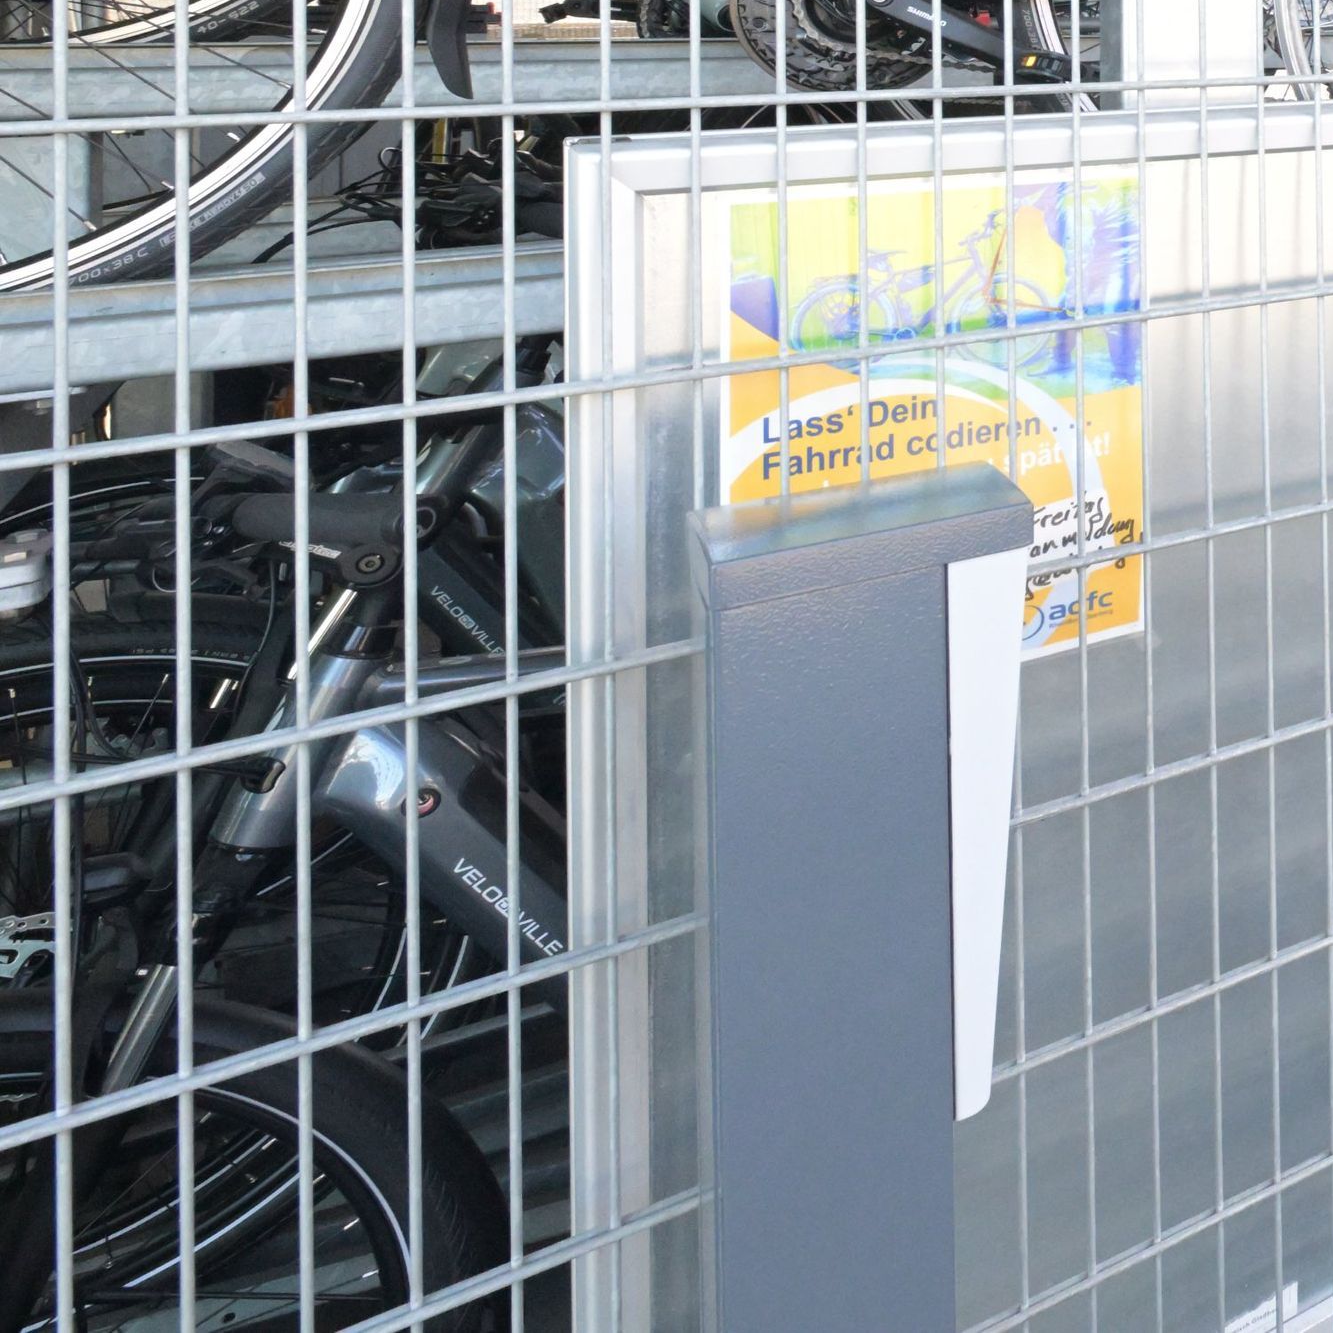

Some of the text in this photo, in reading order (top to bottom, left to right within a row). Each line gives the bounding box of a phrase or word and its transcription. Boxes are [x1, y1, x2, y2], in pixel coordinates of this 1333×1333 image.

[868, 396, 937, 428] Dein
[763, 435, 895, 480] Fahrrad
[906, 417, 1041, 457] codieren
